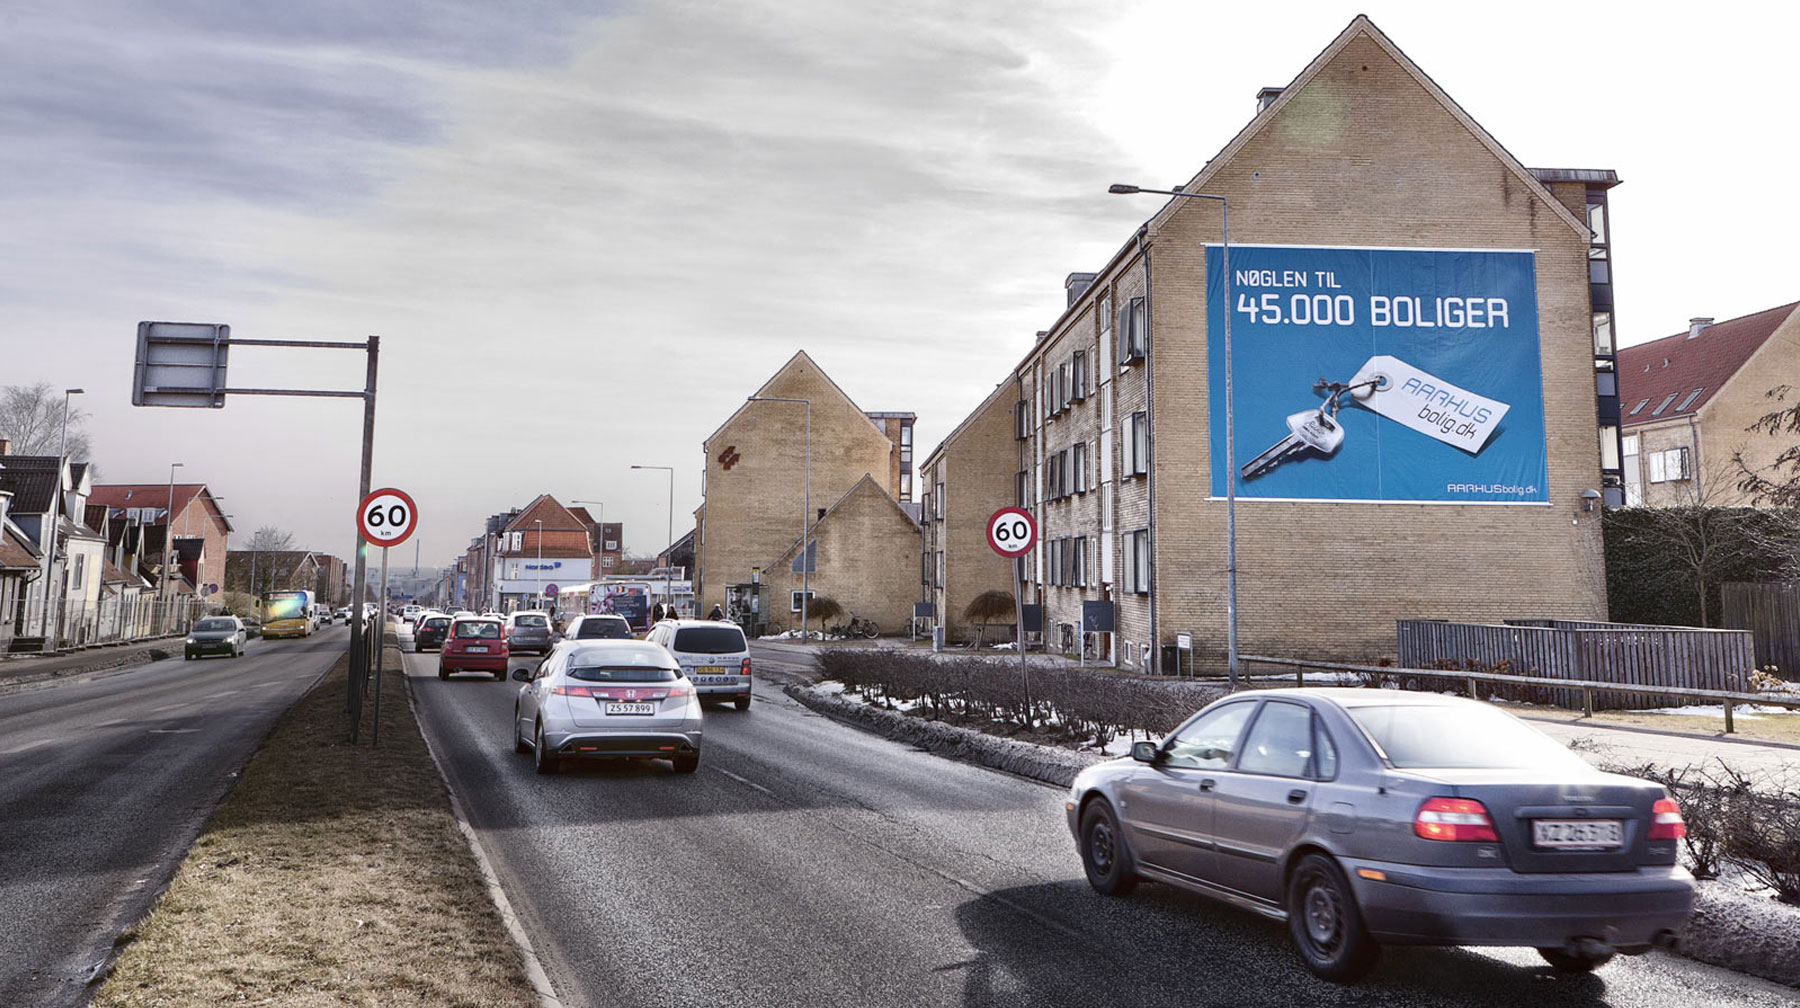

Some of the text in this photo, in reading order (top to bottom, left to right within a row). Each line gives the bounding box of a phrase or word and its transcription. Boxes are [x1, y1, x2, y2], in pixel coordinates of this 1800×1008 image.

[1236, 270, 1342, 289] NØGLEN TIL
[1237, 293, 1509, 328] 45.000 BOLIGER
[1401, 377, 1492, 424] AARHUS
[1418, 404, 1477, 440] bolig.dk
[1447, 483, 1538, 496] AARHUSbolig.dk
[367, 504, 407, 527] 60
[996, 521, 1027, 541] 60
[610, 704, 651, 713] ZS 57 899
